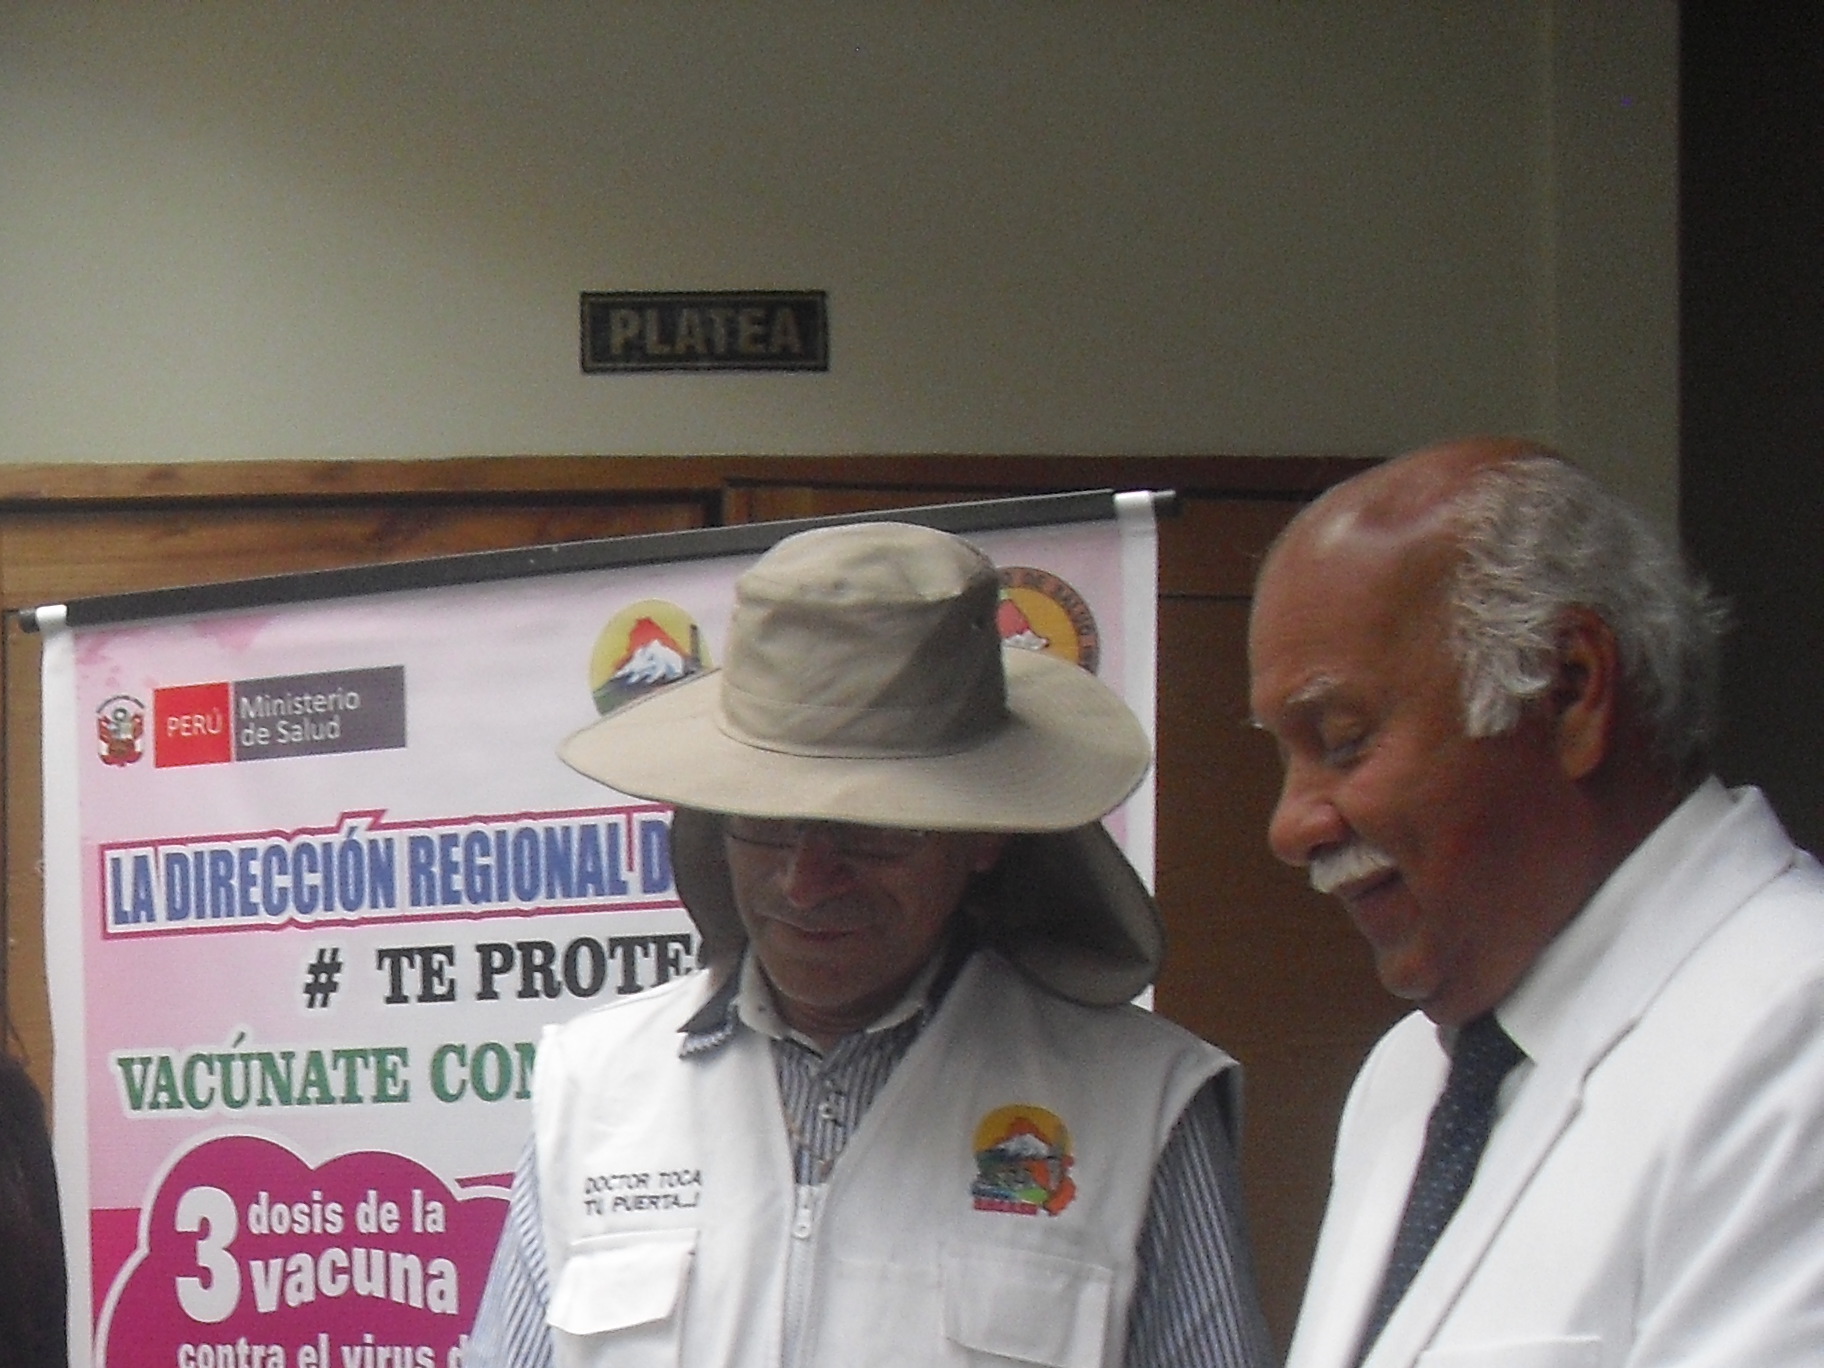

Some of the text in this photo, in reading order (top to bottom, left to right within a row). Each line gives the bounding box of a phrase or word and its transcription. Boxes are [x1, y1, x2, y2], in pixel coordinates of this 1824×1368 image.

[608, 306, 803, 354] PLATEA
[167, 706, 224, 737] PERÚ
[240, 688, 362, 719] Ministerio
[241, 716, 342, 747] de Salud
[110, 854, 157, 925] LA
[164, 825, 396, 922] DIRECCIÓN
[408, 821, 629, 907] REGIONAL
[376, 945, 456, 1005] TE
[117, 1032, 410, 1111] VACÚNATE
[583, 1168, 703, 1195] DOCTOR TOCA
[176, 1185, 447, 1324] 3 dosis de la
[249, 1247, 460, 1316] vacuna
